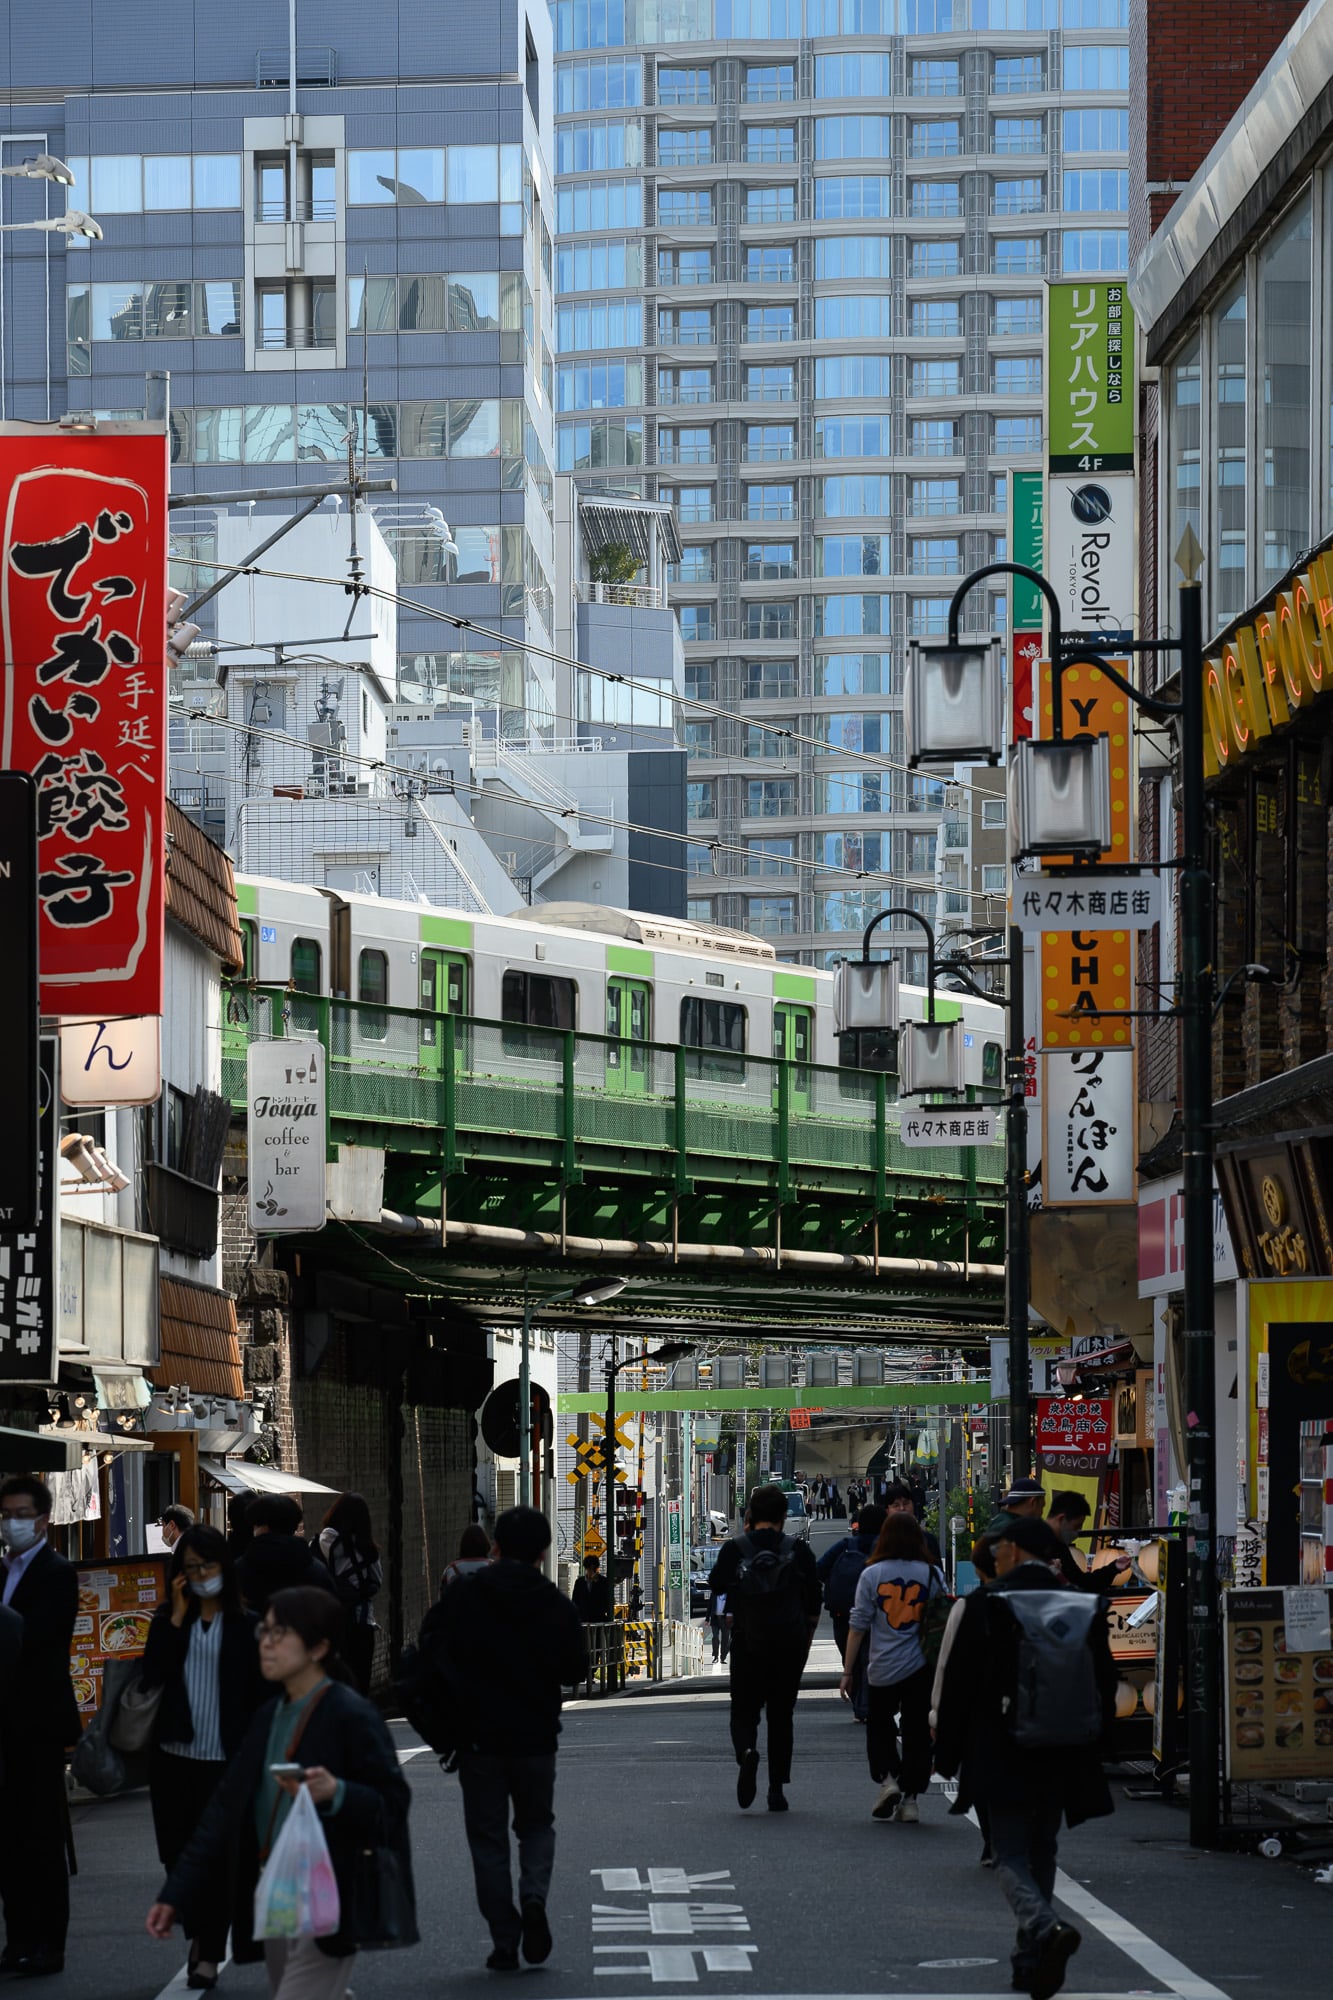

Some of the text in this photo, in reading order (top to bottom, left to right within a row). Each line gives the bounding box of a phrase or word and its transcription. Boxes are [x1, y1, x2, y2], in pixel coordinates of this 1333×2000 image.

[1107, 288, 1122, 403] お部屋探しなら
[1068, 289, 1100, 450] リアハウス
[1077, 455, 1103, 471] 4F
[1069, 562, 1077, 596] TOKYO
[1081, 533, 1111, 623] Revolt
[115, 671, 156, 783] 手延べ
[1022, 889, 1151, 916] 代々木商店街
[254, 1096, 318, 1122] Tonga
[264, 1127, 310, 1146] coffee
[906, 1120, 990, 1137] 代々木商店街
[275, 1158, 301, 1176] bar
[1048, 1402, 1102, 1415] 炭火串焼
[1040, 1418, 1108, 1433] 焼鳥商会
[1064, 1434, 1083, 1442] 2F
[1088, 1443, 1107, 1451] 入口
